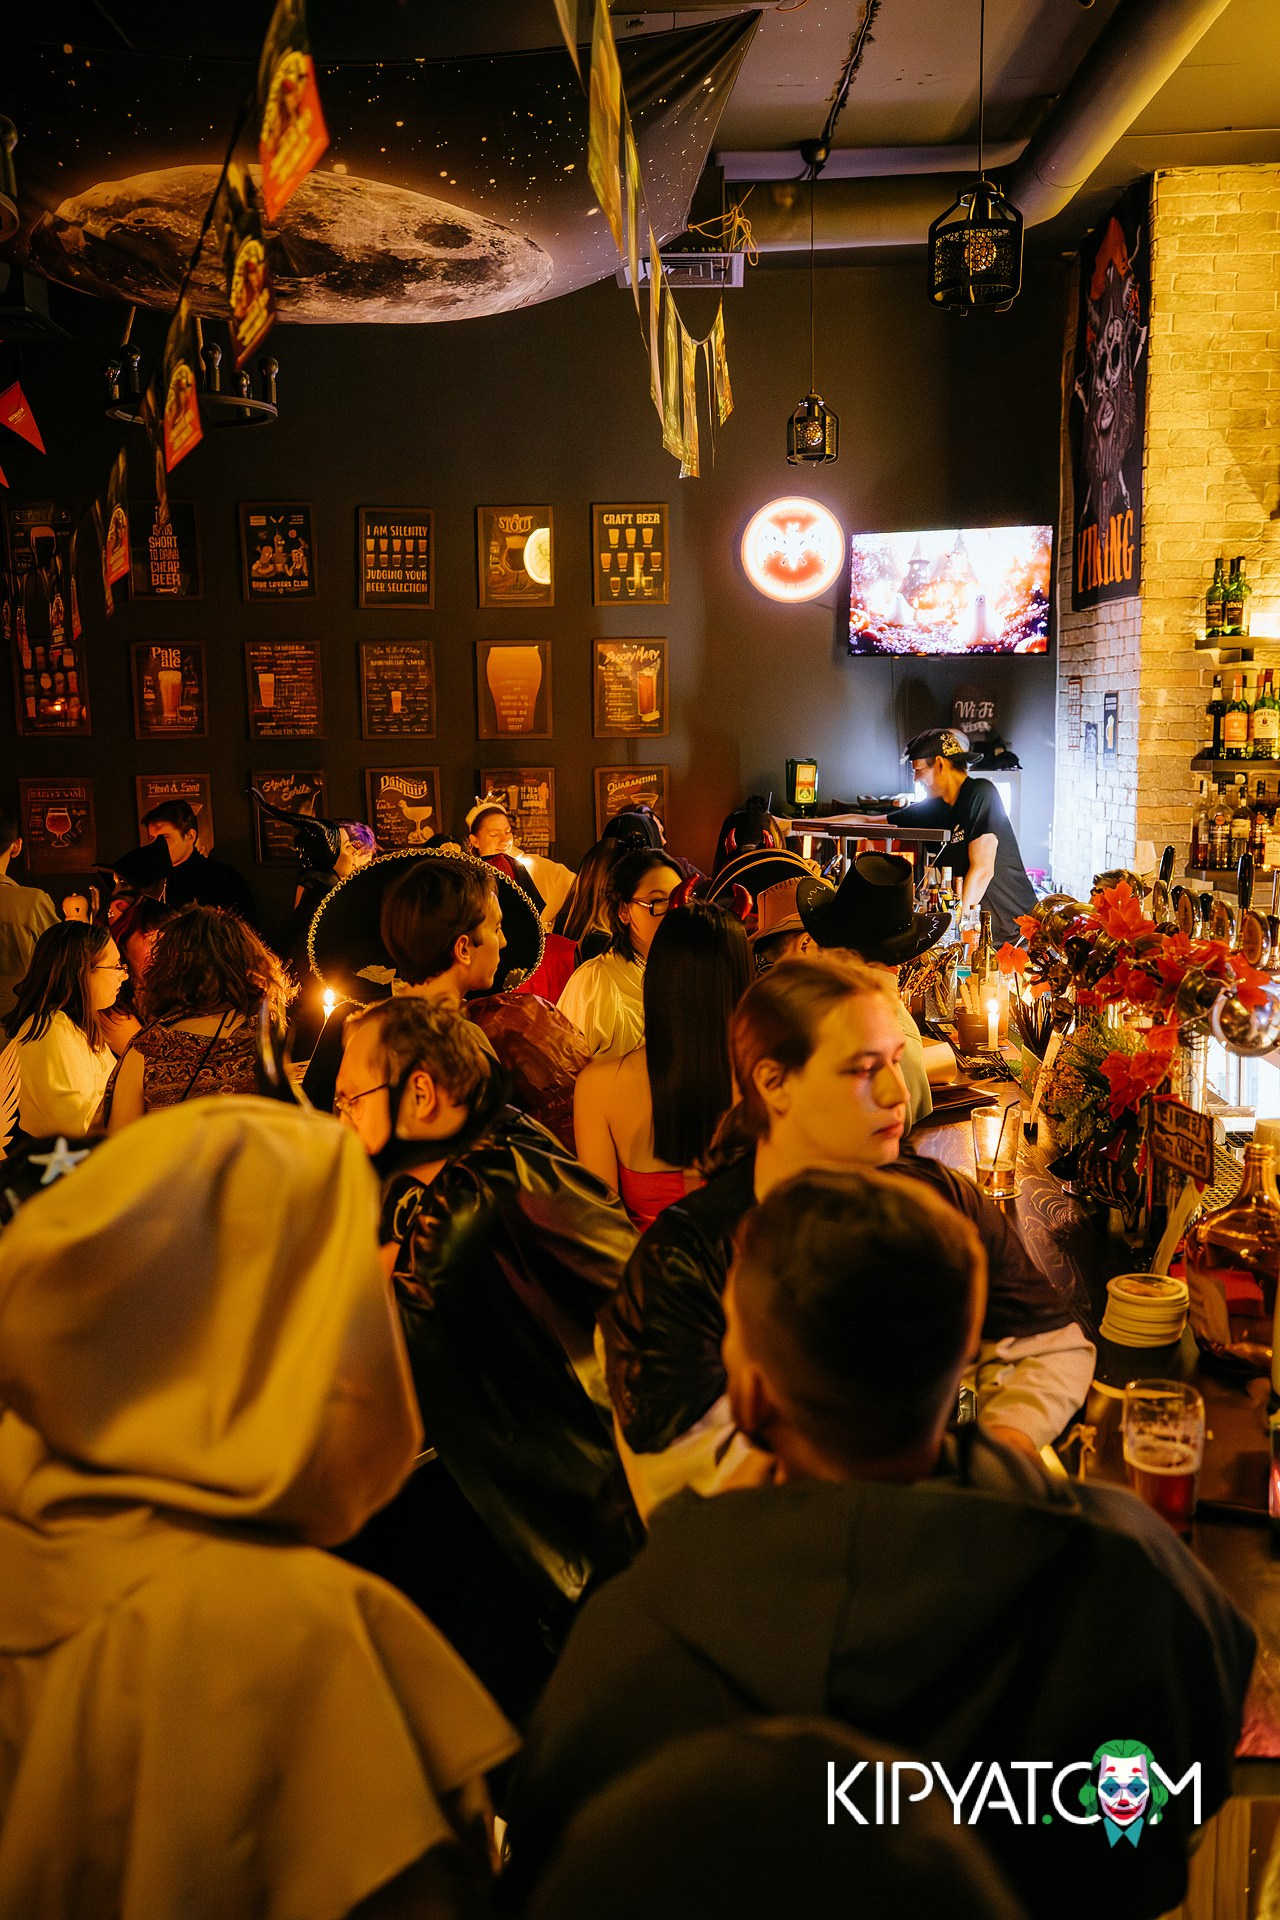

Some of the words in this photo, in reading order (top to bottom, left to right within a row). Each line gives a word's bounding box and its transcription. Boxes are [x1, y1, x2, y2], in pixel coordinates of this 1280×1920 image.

[603, 513, 633, 525] CRAFT
[636, 513, 660, 524] BEER
[366, 525, 371, 536] I
[373, 525, 388, 536] AM
[390, 525, 428, 537] SILENTLY
[148, 535, 177, 548] SHORT
[1078, 509, 1135, 593] VIKING
[150, 561, 180, 573] CHEAP
[151, 573, 181, 586] BEER
[366, 569, 403, 580] JUDGING
[405, 570, 427, 581] YOUR
[366, 582, 386, 592] BEER
[388, 582, 428, 593] SELECTION
